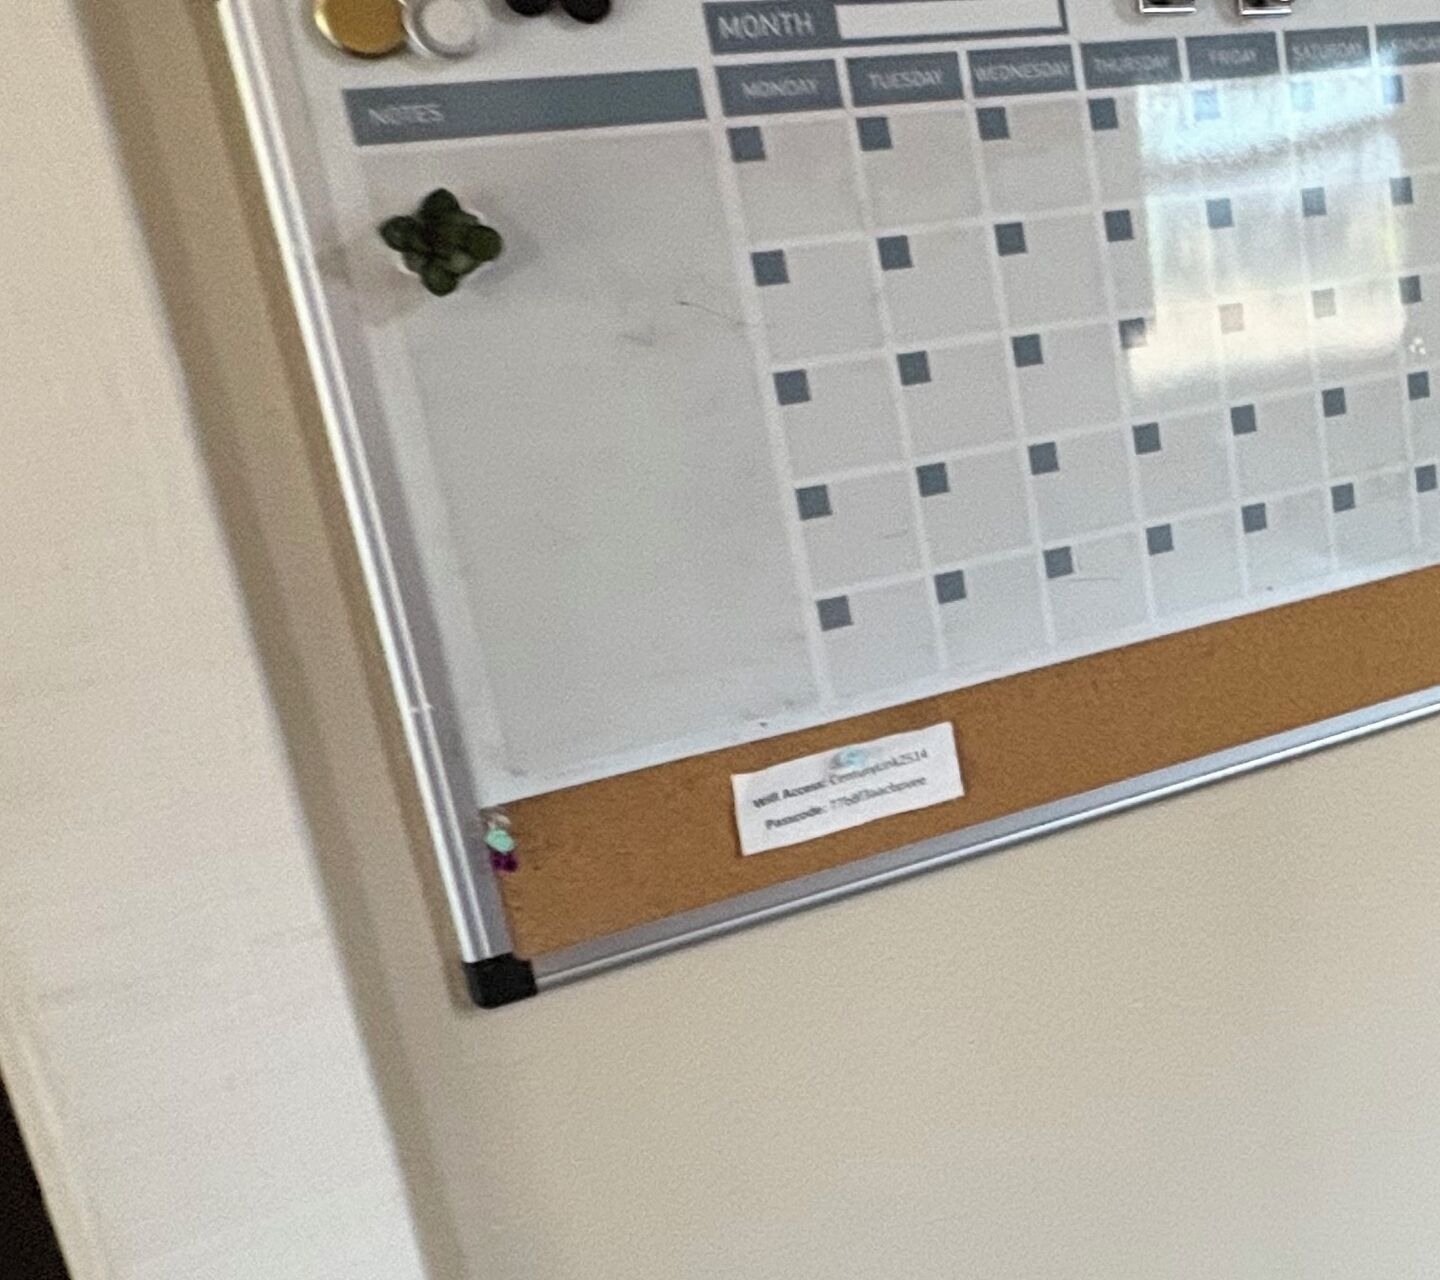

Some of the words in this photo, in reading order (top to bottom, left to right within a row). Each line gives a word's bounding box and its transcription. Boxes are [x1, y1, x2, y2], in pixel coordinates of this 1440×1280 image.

[717, 10, 816, 40] MONTH
[868, 68, 944, 90] TUESDAY
[973, 61, 1071, 82] WEDNESDAY
[742, 76, 819, 99] MONDAY
[367, 103, 445, 126] NOTES
